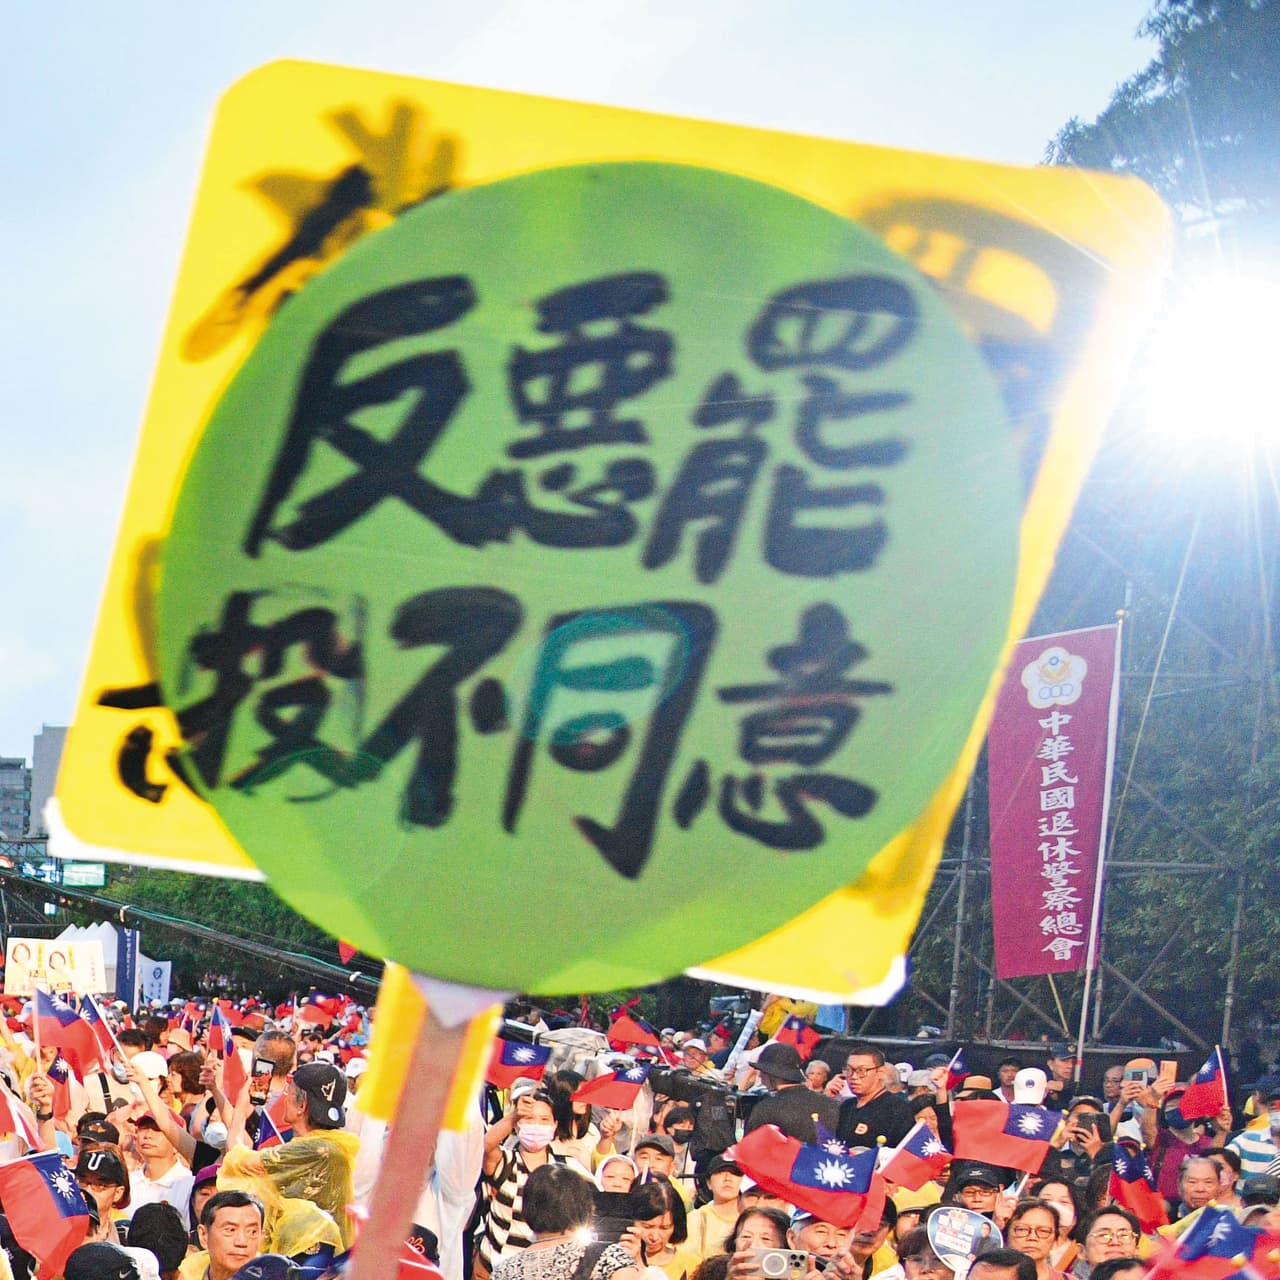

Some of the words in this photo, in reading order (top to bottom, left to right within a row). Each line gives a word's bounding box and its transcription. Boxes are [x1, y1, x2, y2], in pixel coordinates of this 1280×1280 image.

[98, 584, 893, 880] 投不同意
[1037, 711, 1085, 961] 中華民國退休警察總會
